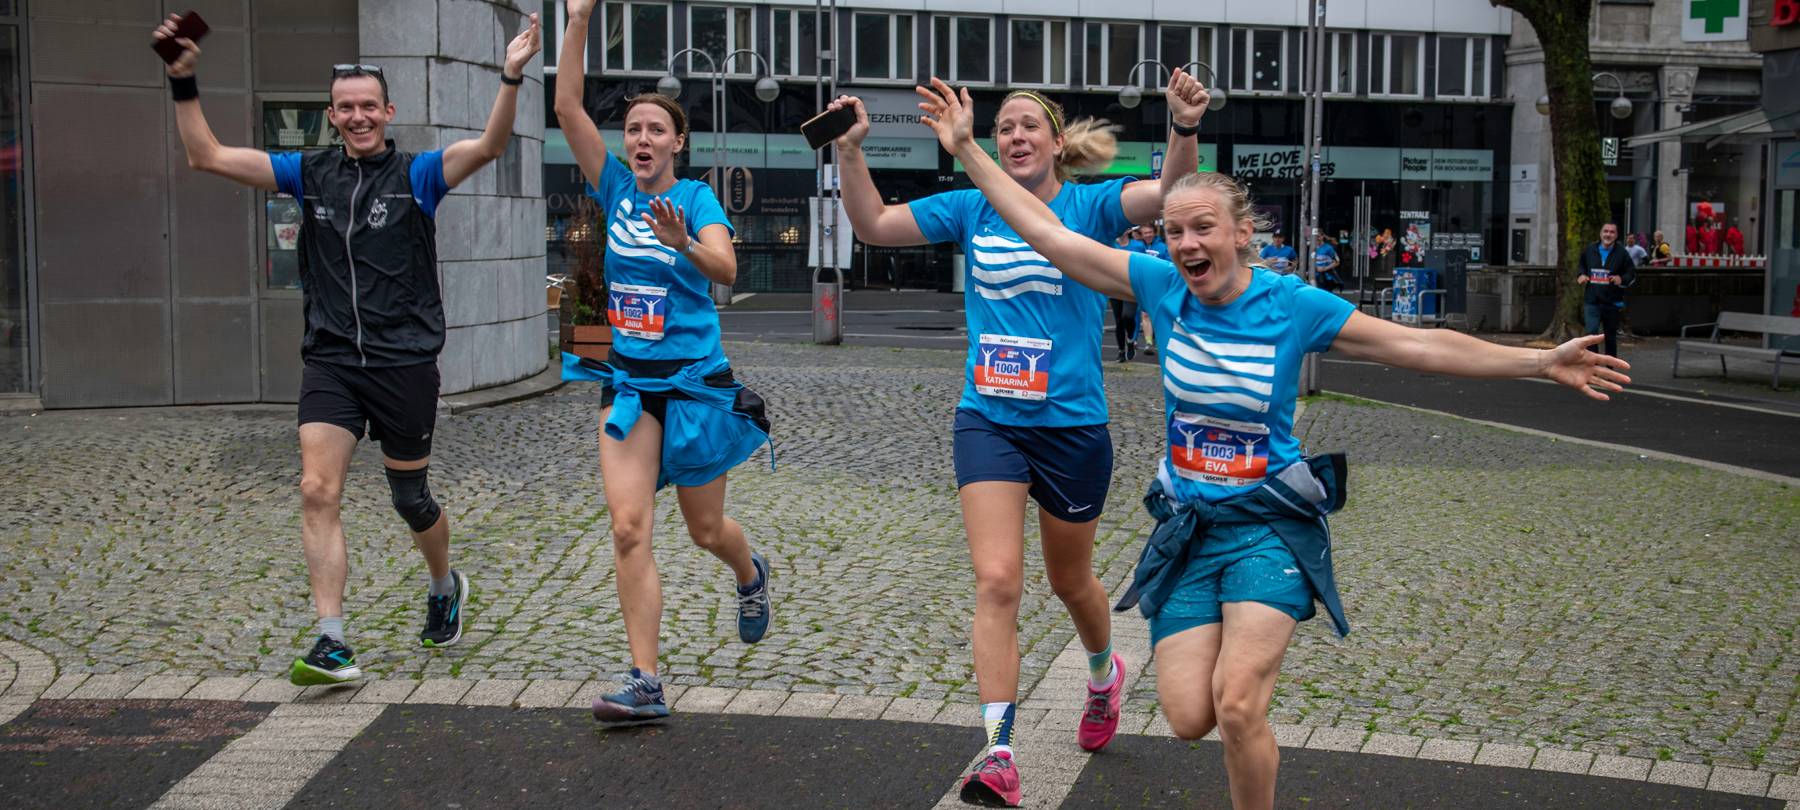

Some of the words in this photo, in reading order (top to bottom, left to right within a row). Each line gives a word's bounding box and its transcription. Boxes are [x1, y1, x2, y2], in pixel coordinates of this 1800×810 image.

[1238, 154, 1260, 168] WE
[1262, 151, 1301, 167] LOVE
[1278, 163, 1336, 178] STOES
[1403, 164, 1427, 172] People
[1400, 211, 1430, 219] ZENTRALE
[624, 308, 642, 318] 1002
[624, 319, 644, 329] ANNA
[995, 362, 1019, 376] 1004
[985, 376, 1029, 387] KATHARINA
[1203, 444, 1234, 460] 1003
[1205, 461, 1228, 474] EVA
